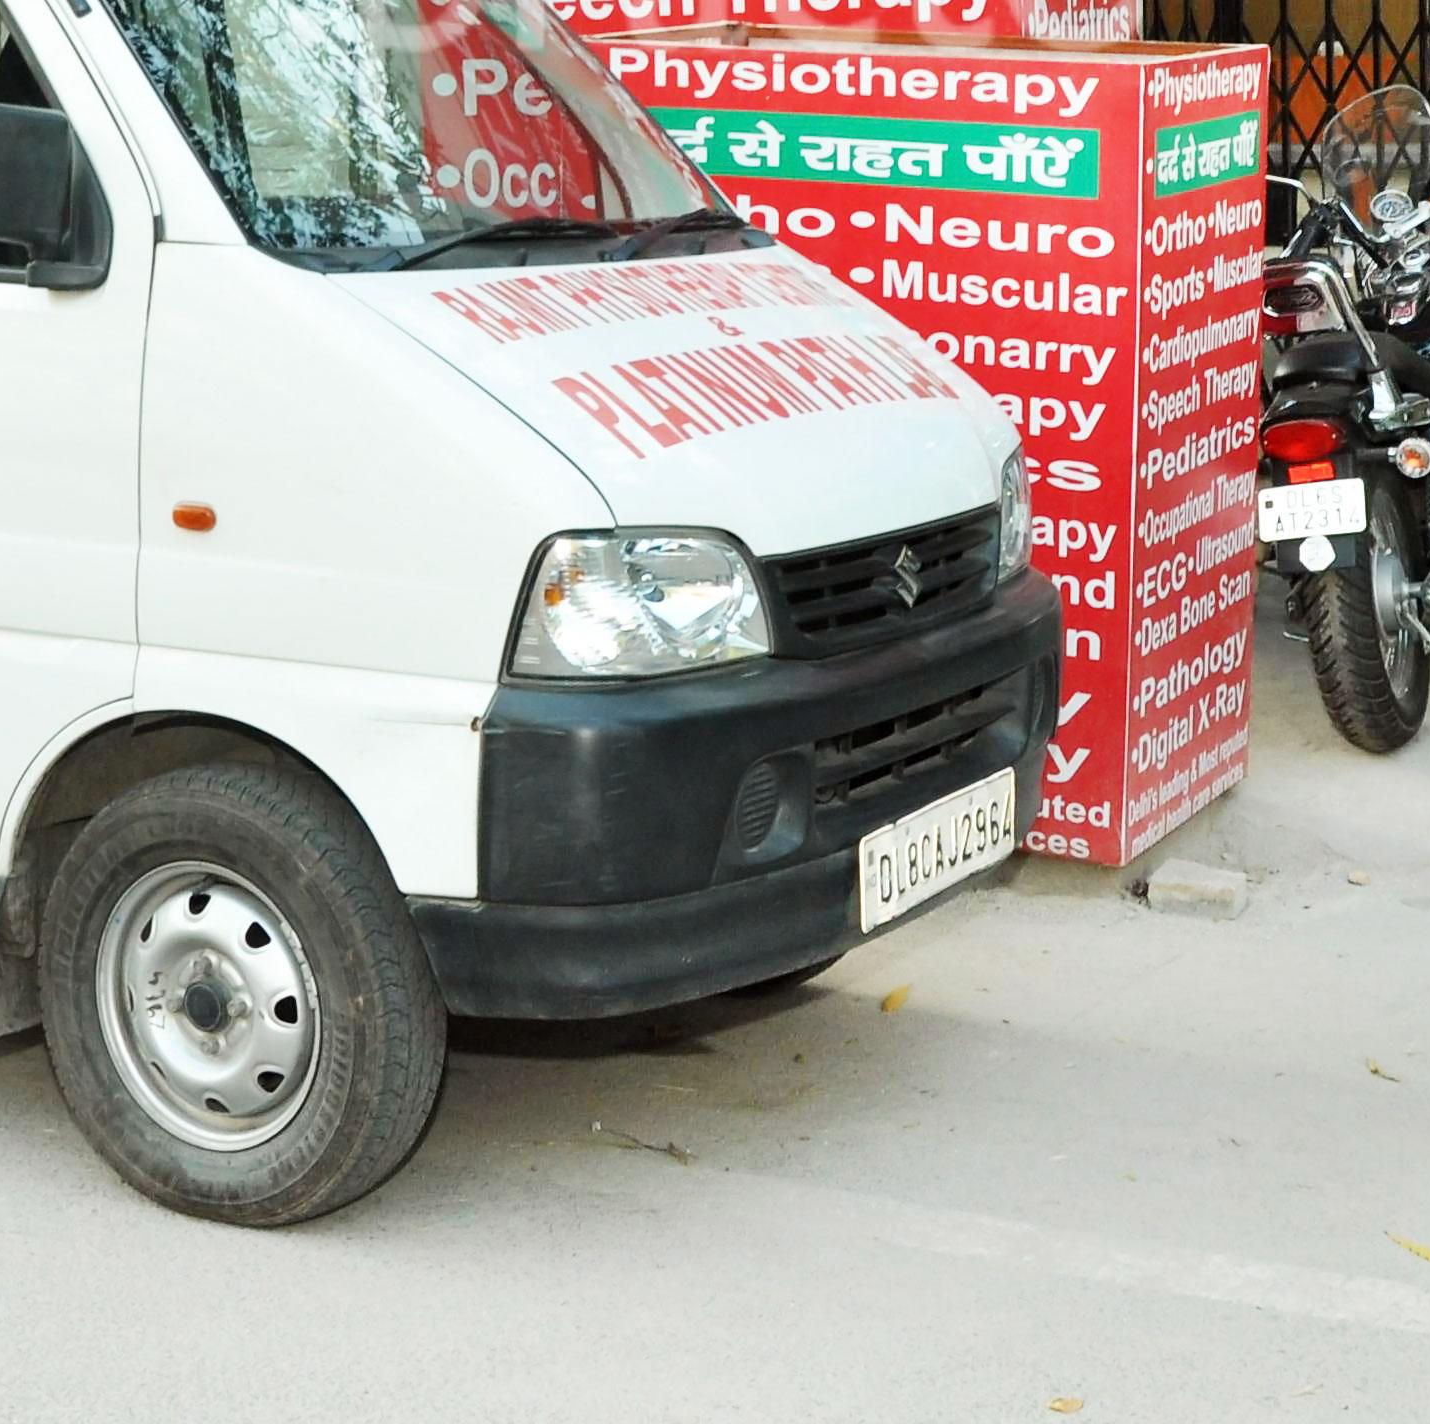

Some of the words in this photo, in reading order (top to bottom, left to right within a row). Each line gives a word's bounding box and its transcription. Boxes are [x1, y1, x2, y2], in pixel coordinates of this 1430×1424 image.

[609, 47, 1099, 117] Physiotherapy
[1154, 61, 1262, 116] Physiotherapy
[727, 120, 786, 168] से
[799, 135, 948, 179] राहत
[1157, 133, 1181, 185] दर्द
[1182, 132, 1197, 182] से
[1198, 136, 1231, 178] राहत
[884, 203, 1116, 259] Neuro
[1151, 210, 1206, 257] Ortho
[1214, 198, 1262, 239] Neuro
[882, 258, 1128, 318] Muscular
[1150, 265, 1205, 321] Sports
[1213, 244, 1264, 293] Muscular
[707, 316, 745, 337] &
[1149, 307, 1261, 374] Cardiopulmonarry
[552, 342, 821, 459] PLATINUM
[1147, 375, 1201, 437] Speech
[1204, 359, 1258, 407] Therapy
[1146, 416, 1256, 490] Pediatrics
[1144, 479, 1214, 548] Occupational
[1216, 468, 1257, 513] Therapy
[1142, 551, 1187, 609] ECG
[1195, 511, 1255, 576] Ultrasound
[1141, 611, 1177, 657] Dexa
[1180, 588, 1216, 634] Bone
[1219, 569, 1251, 611] Scan
[1140, 628, 1248, 718] Pathology
[1138, 703, 1194, 774] Digital
[1197, 678, 1247, 736] X-Ray
[1159, 769, 1190, 805] leading
[1190, 757, 1198, 782] &
[1198, 746, 1219, 776] Most
[1220, 721, 1248, 764] reputed
[1212, 762, 1244, 798] services
[879, 790, 1012, 904] DL8CAJ2964
